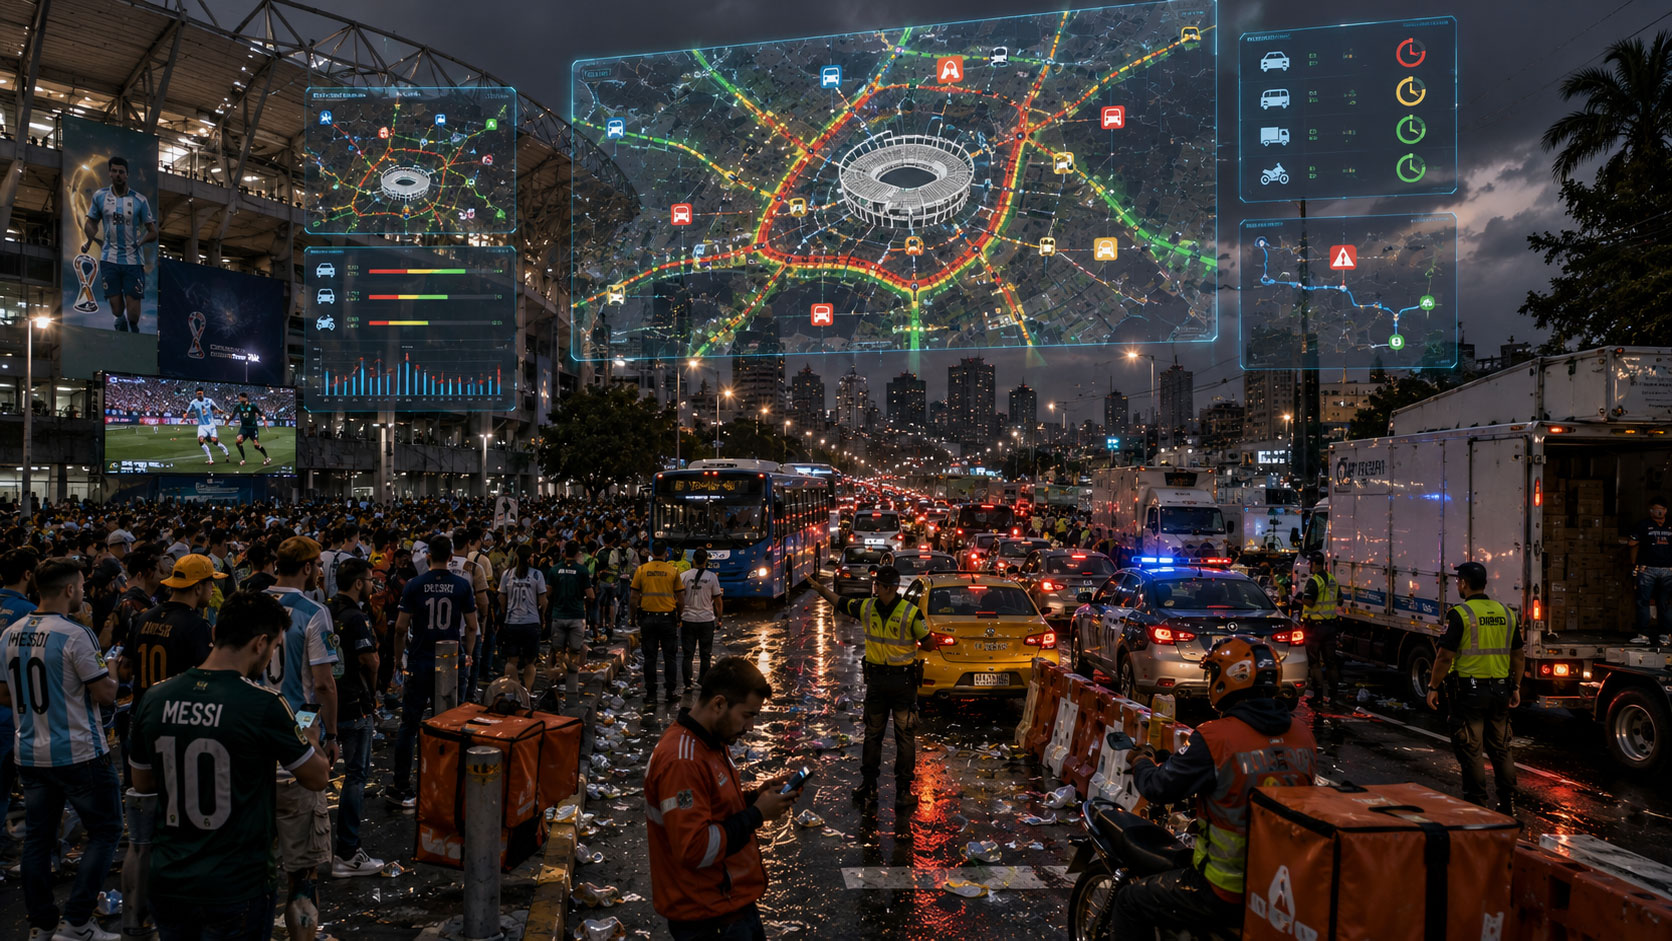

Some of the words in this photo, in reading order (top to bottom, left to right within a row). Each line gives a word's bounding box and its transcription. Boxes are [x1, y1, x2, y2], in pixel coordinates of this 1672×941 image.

[425, 597, 452, 631] 10
[8, 656, 50, 716] 10
[137, 643, 167, 689] 10
[161, 700, 224, 728] MESSI
[154, 735, 232, 830] 10
